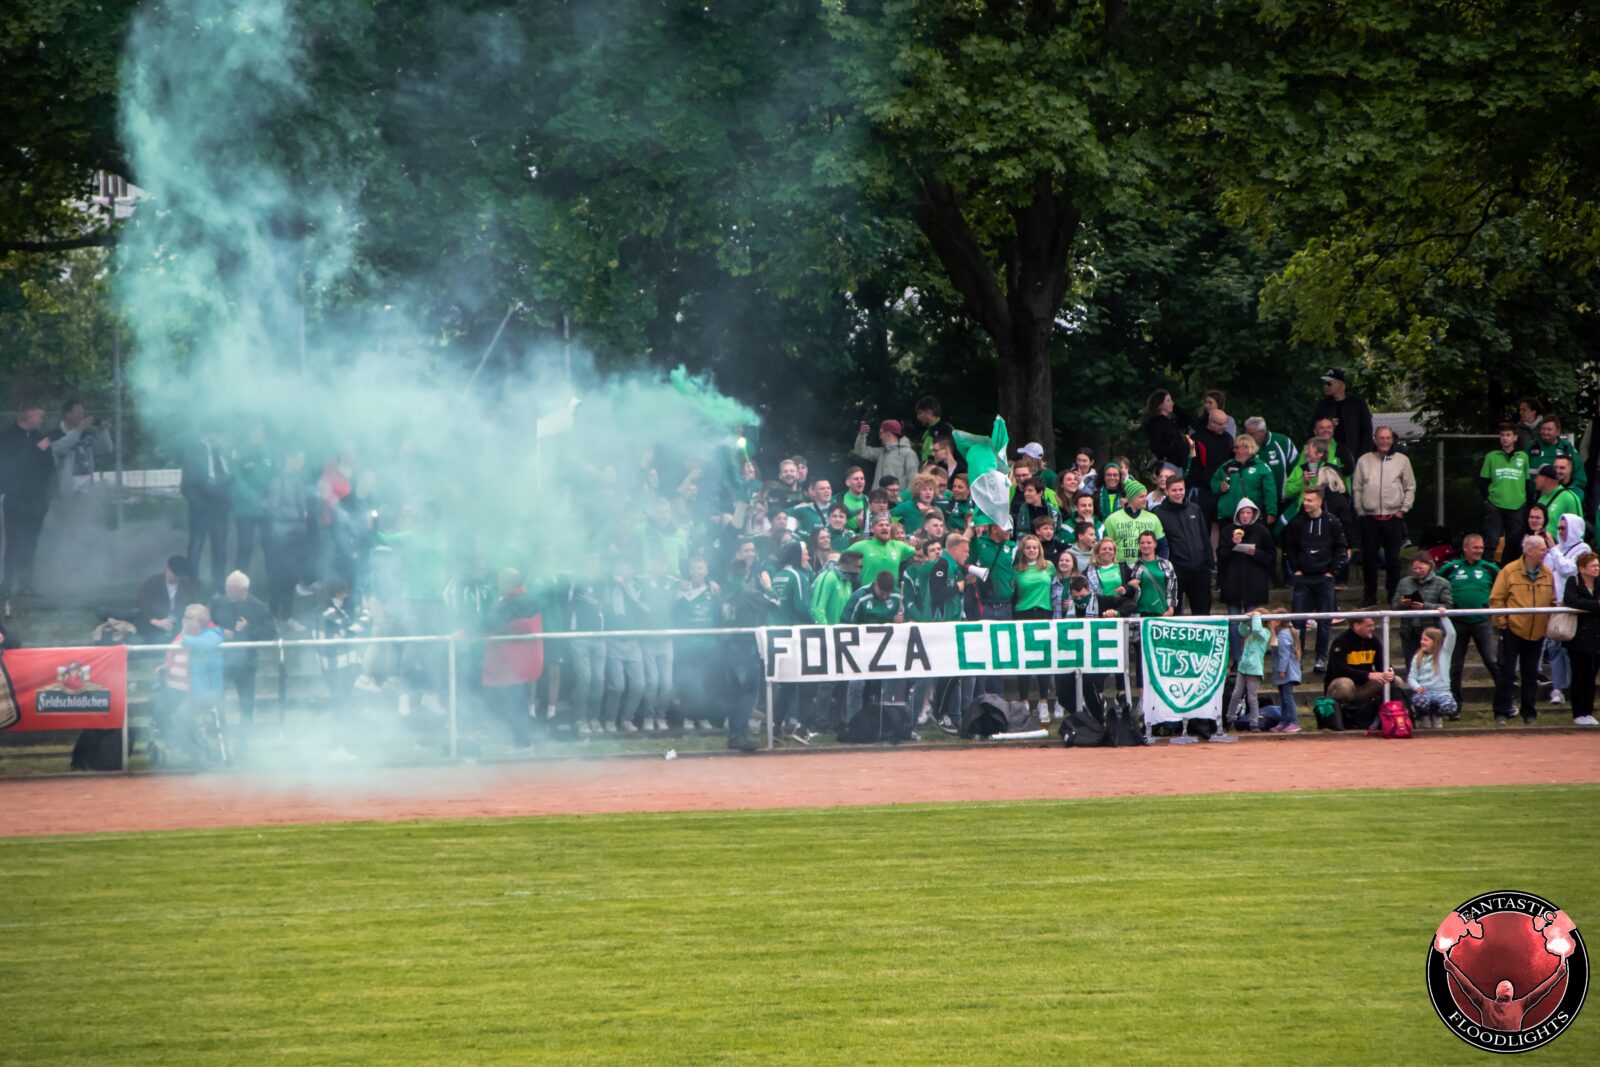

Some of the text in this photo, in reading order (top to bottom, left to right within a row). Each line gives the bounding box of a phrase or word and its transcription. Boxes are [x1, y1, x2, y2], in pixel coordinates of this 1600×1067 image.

[766, 621, 1119, 677] FORZA COSSE
[1155, 647, 1209, 676] TSV
[38, 692, 108, 711] Feldschlößchen
